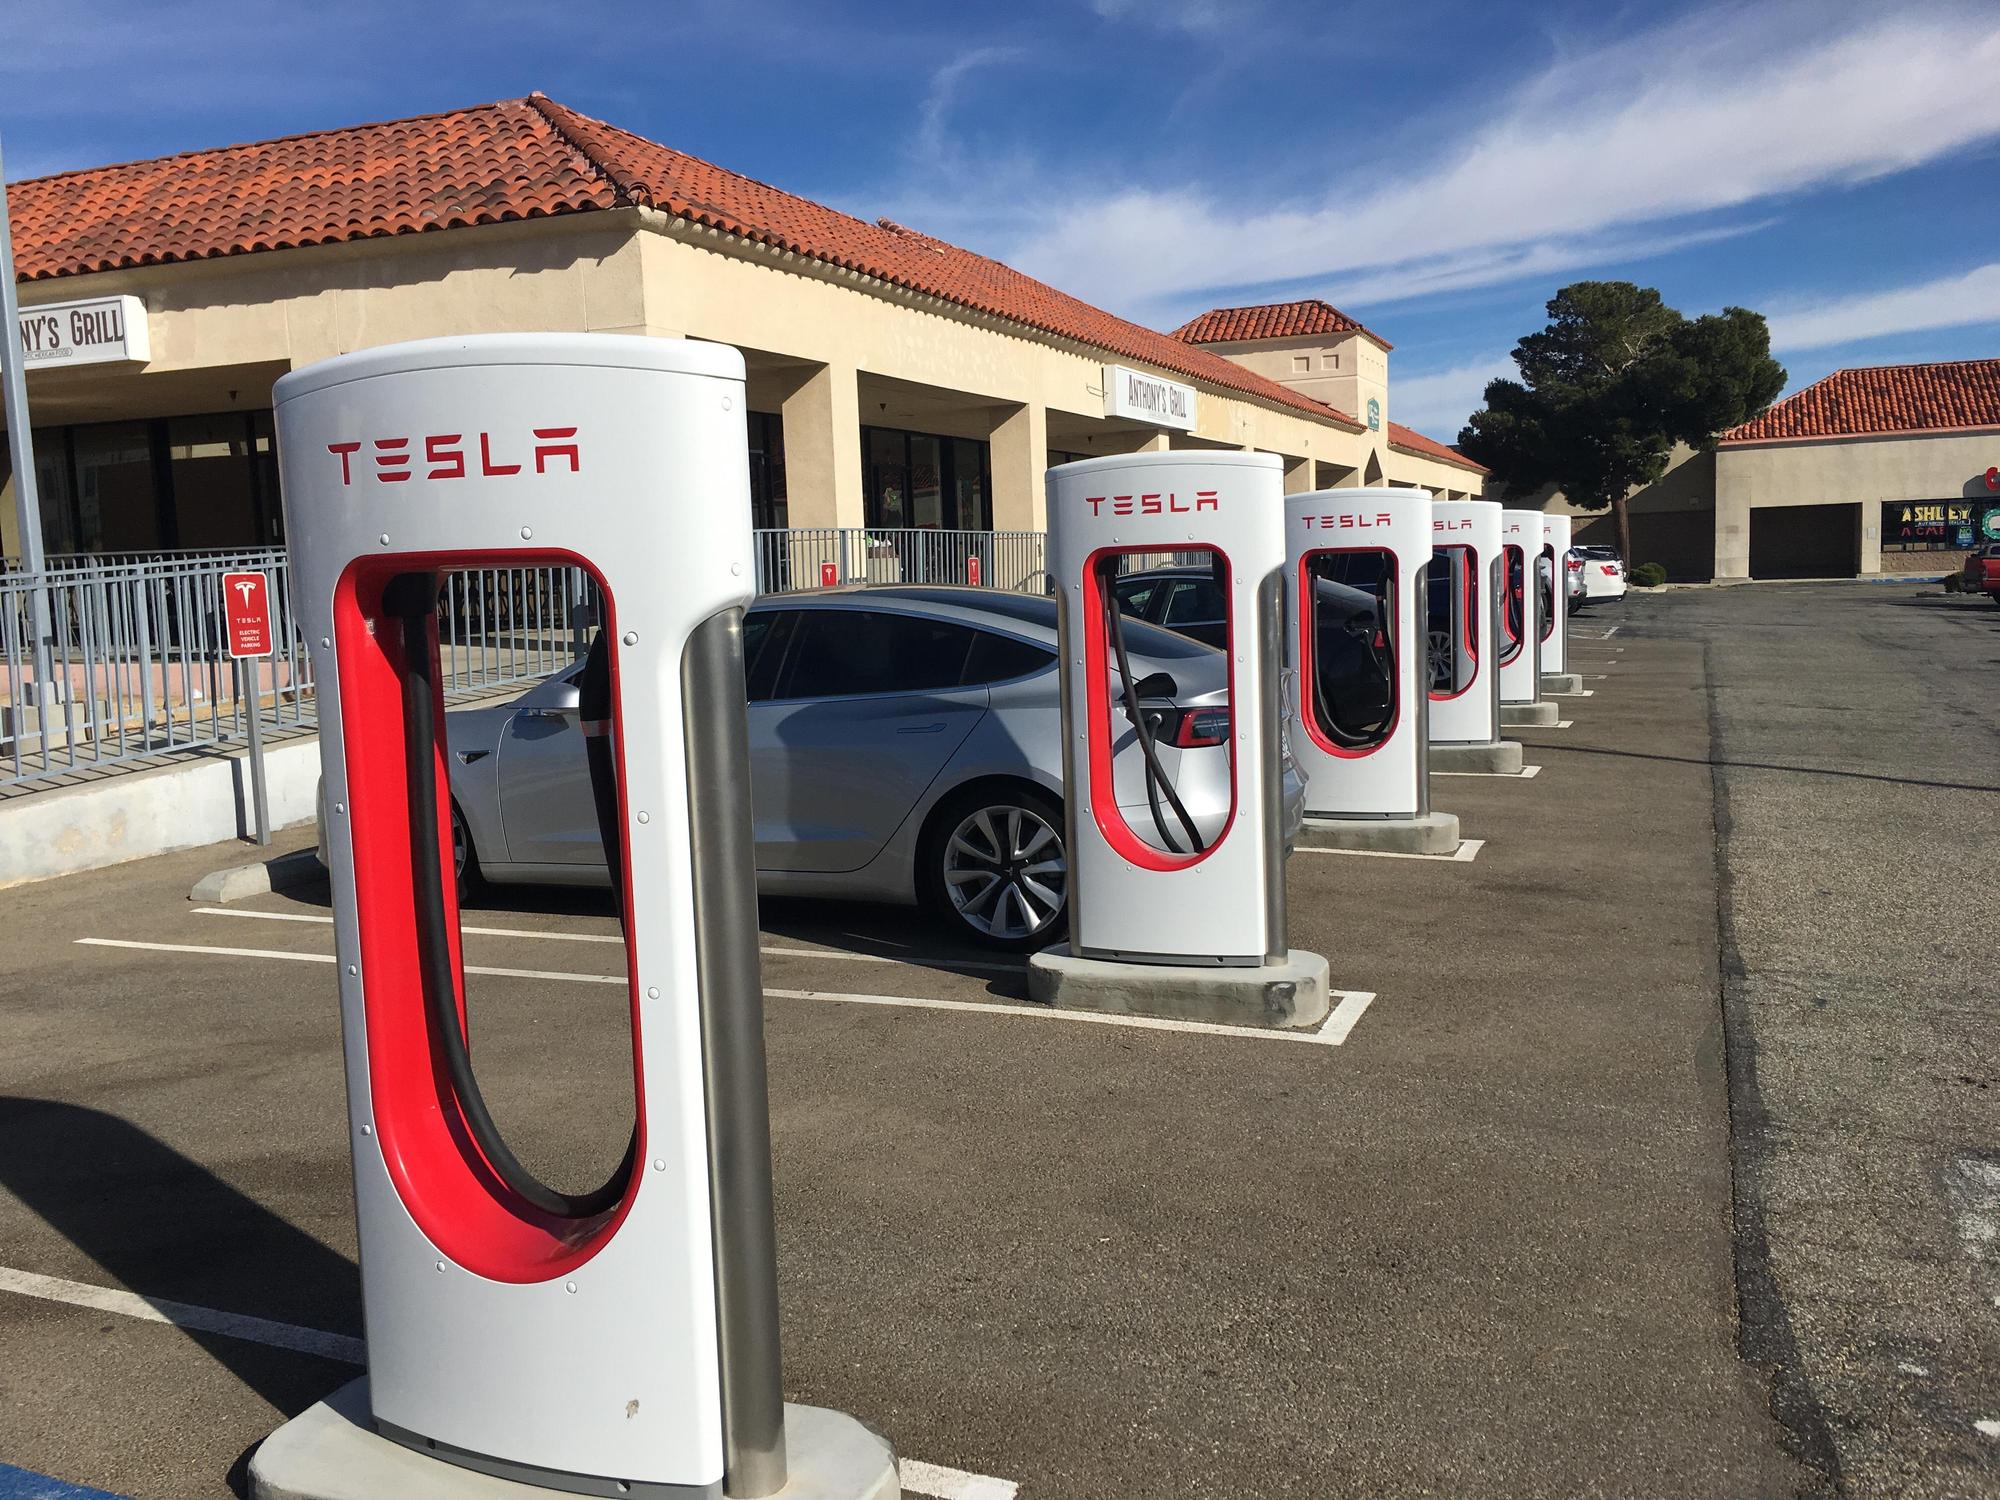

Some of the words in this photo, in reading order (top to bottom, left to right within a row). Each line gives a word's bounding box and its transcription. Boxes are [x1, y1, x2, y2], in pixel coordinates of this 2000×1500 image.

[20, 315, 60, 350] NY'S
[70, 310, 124, 345] GRILL
[1129, 375, 1166, 413] ANTHONY'S
[1170, 386, 1186, 417] GRILL
[326, 426, 580, 486] TESLA
[1085, 490, 1218, 517] TESLA
[1902, 505, 1972, 521] ASHLEY
[1301, 513, 1391, 530] TESLA
[1433, 519, 1472, 531] SLA
